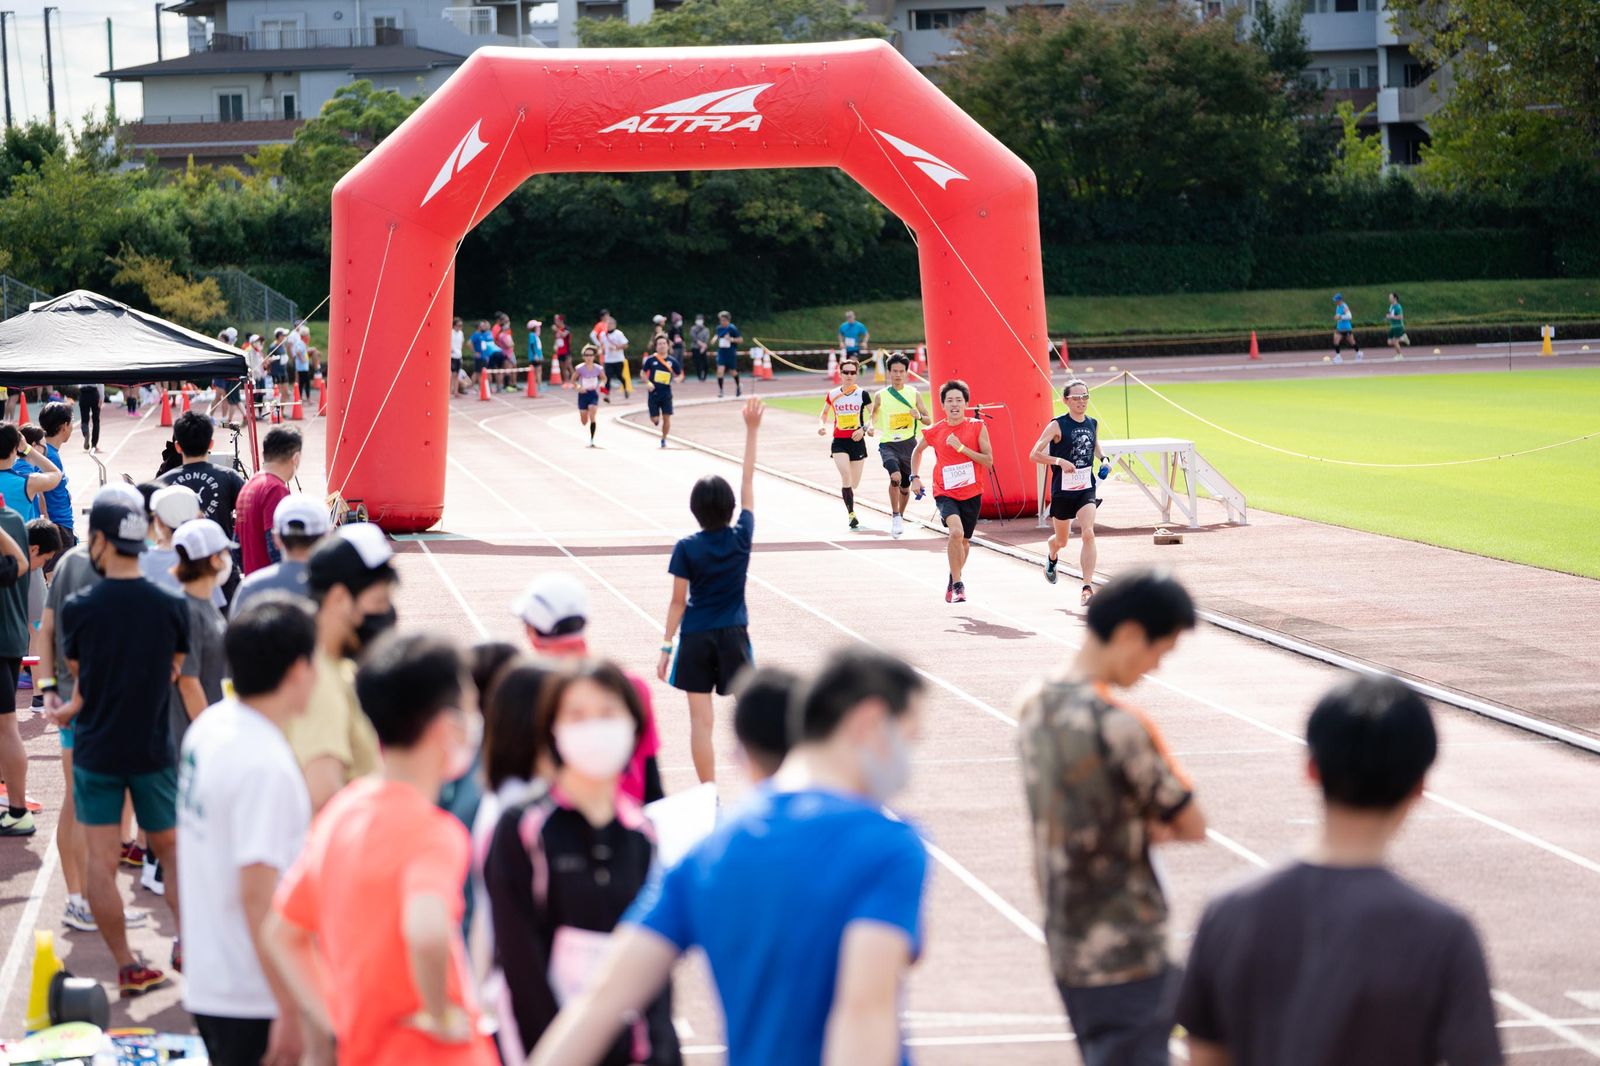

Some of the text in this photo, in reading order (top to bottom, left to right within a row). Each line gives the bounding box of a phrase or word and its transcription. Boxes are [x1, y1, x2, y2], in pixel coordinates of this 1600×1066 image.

[598, 114, 763, 133] ALTRA
[835, 403, 860, 411] tetto
[171, 471, 219, 490] TRONGER
